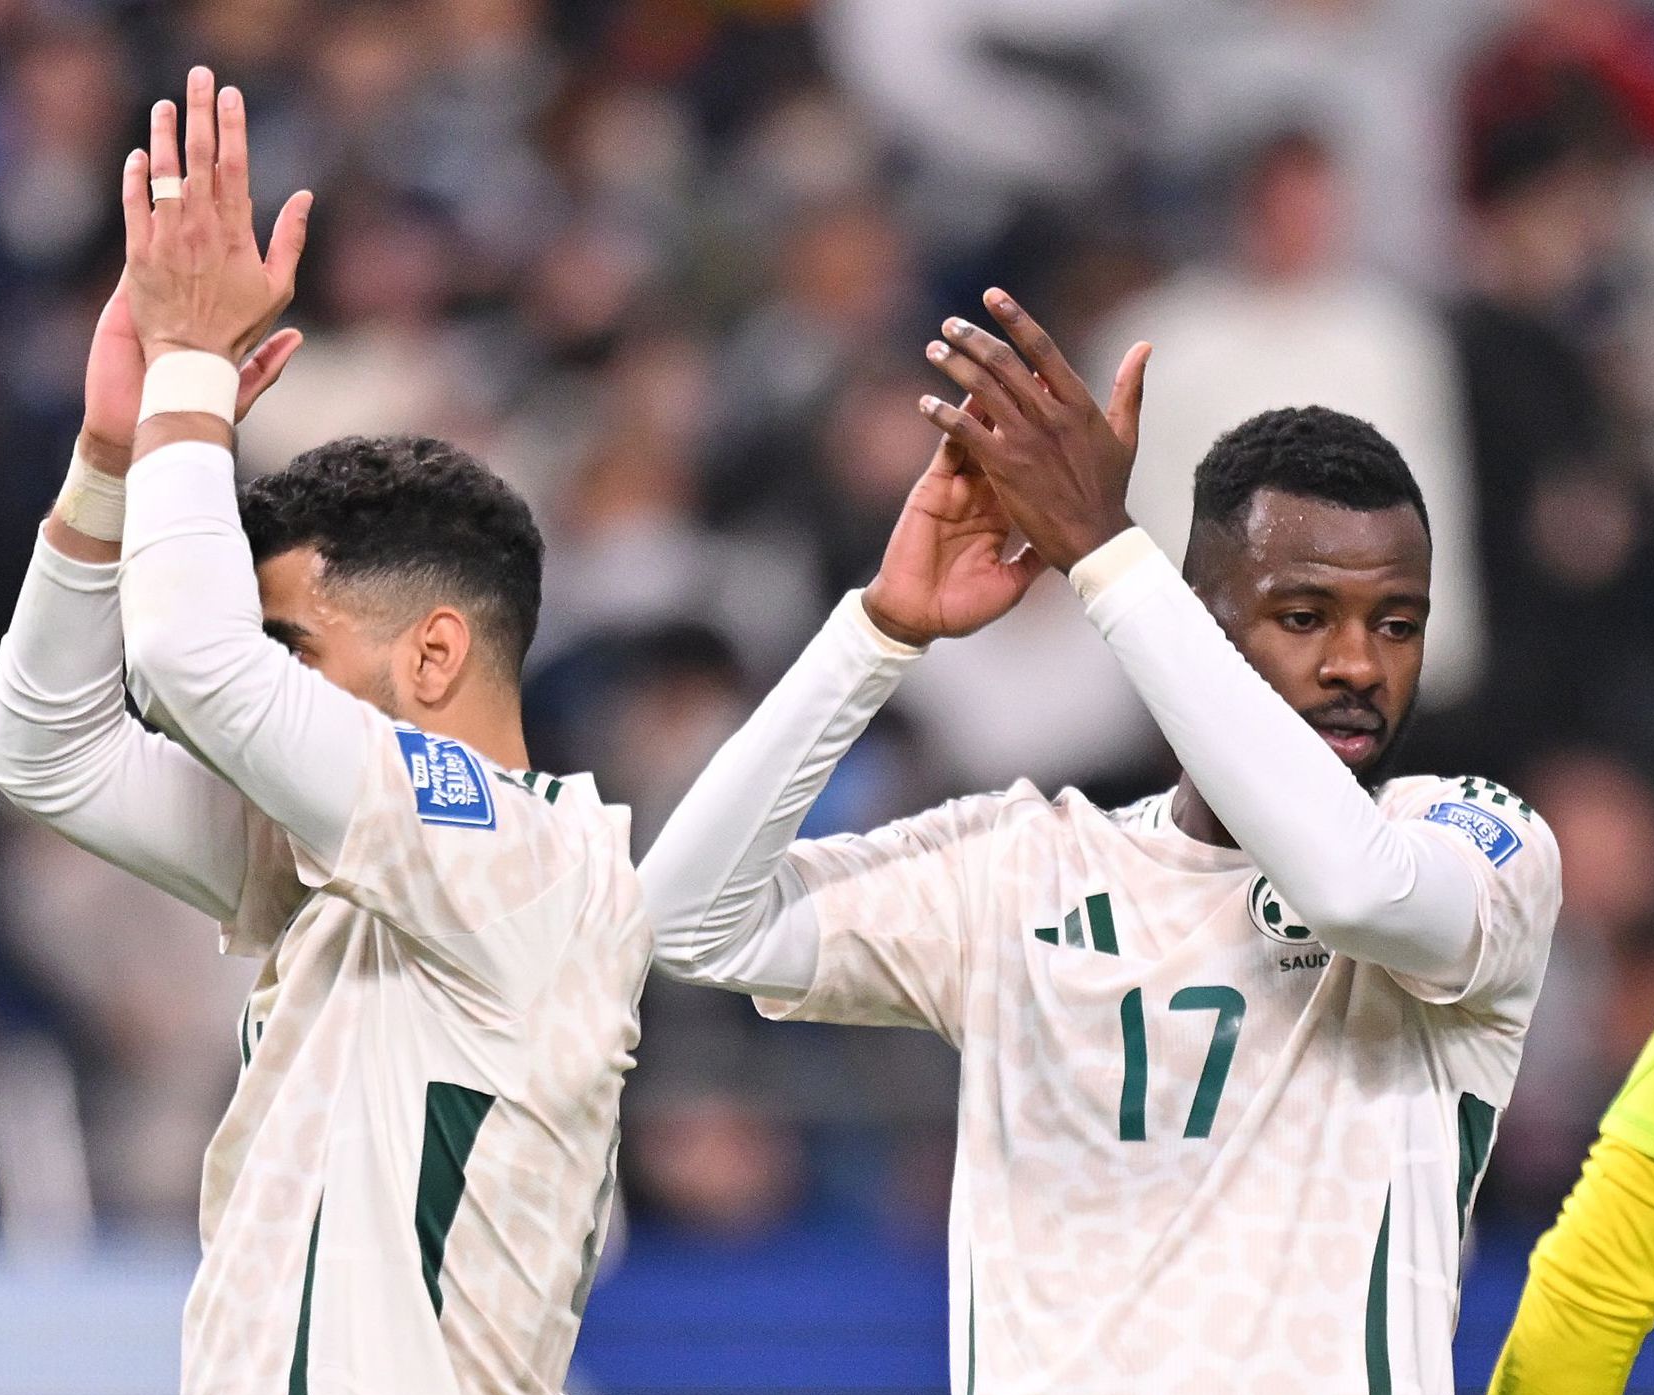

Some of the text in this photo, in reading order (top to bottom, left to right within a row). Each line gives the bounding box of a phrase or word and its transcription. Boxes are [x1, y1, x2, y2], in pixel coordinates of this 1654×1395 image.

[415, 759, 425, 783] FIFA
[1280, 953, 1330, 972] SAUD
[1119, 985, 1247, 1141] 17
